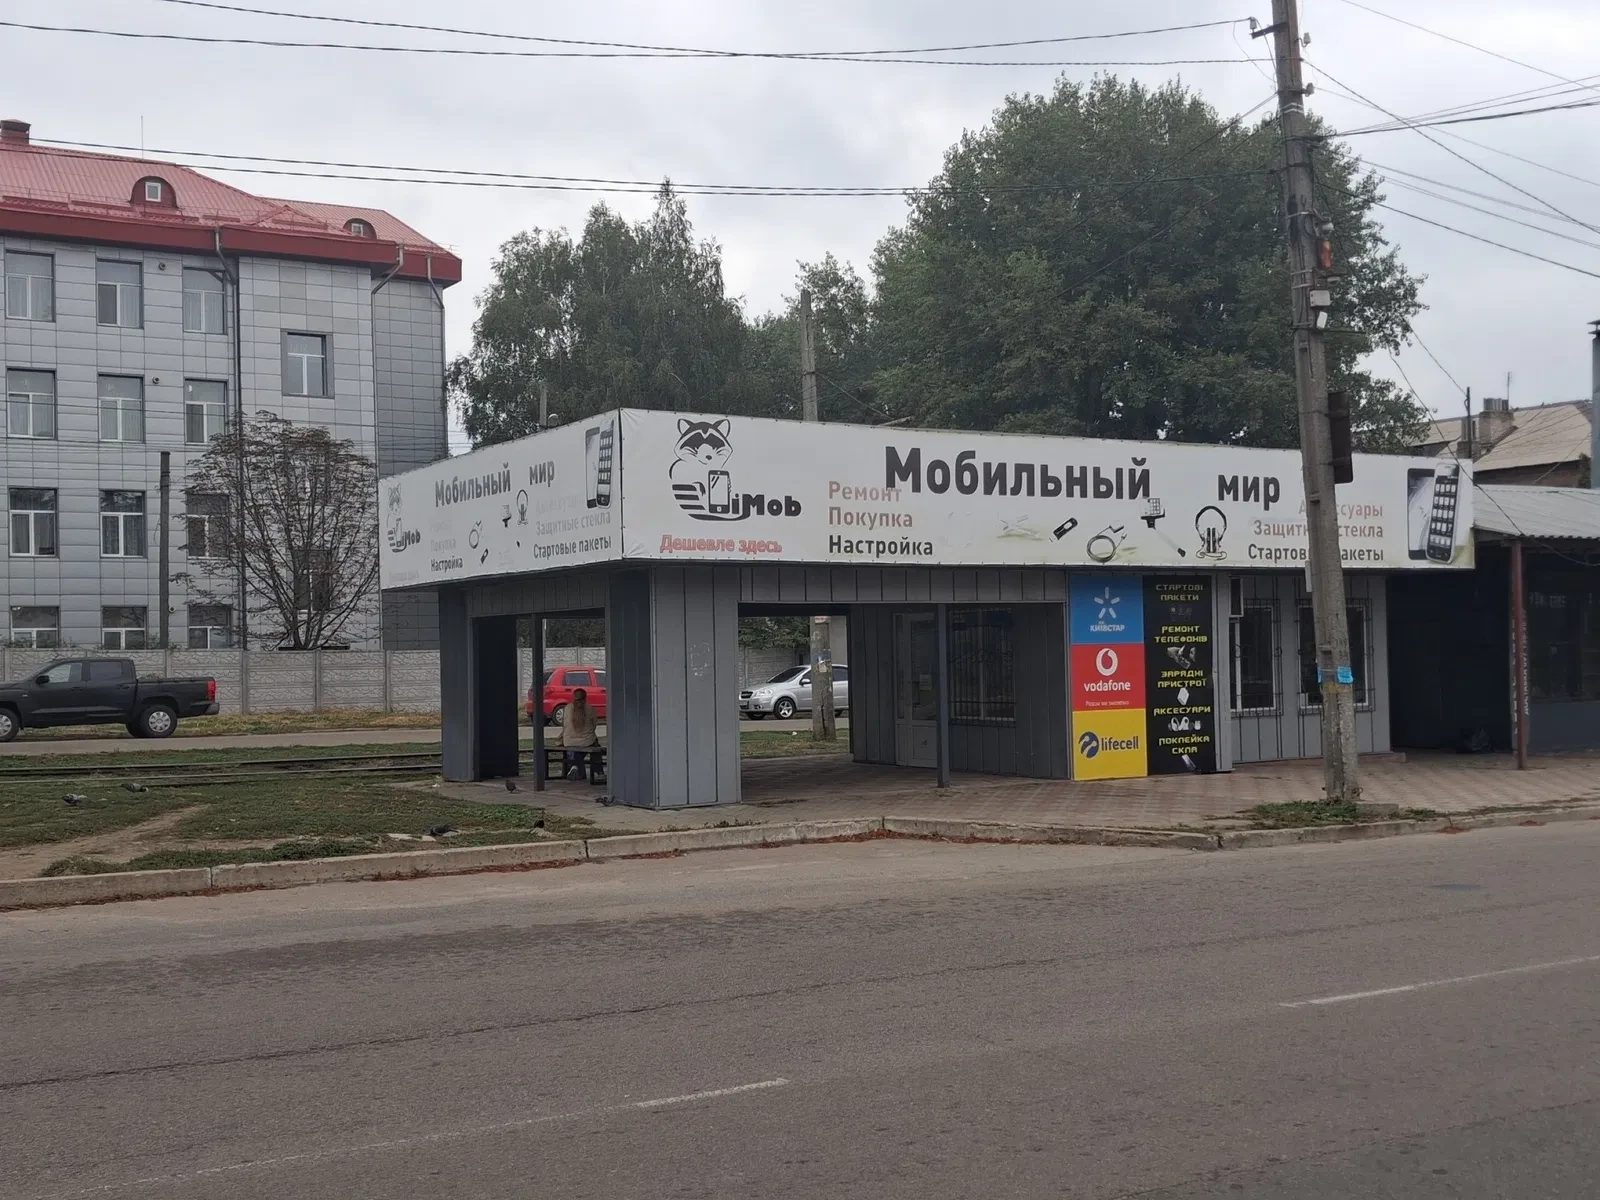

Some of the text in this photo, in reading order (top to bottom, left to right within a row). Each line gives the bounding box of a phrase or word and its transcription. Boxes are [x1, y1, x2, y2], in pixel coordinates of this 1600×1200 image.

[435, 462, 511, 508] Мобильный
[529, 460, 555, 487] мир
[885, 446, 1280, 511] Мобильный мир
[828, 481, 902, 502] Ремонт
[731, 493, 802, 517] iMob
[1298, 499, 1383, 519] Асуары
[536, 511, 611, 536] Защитные стекла
[828, 506, 913, 530] Покупка
[1253, 519, 1384, 540] Защитн стекла
[533, 536, 612, 561] Стартовые пакеты
[659, 534, 783, 554] Дешевле здесь
[828, 534, 933, 558] Настройка
[1248, 543, 1384, 564] Стартов акеты
[430, 555, 464, 574] Настройка
[1154, 635, 1207, 643] ТЕЛЕФОНІВ
[1161, 626, 1200, 634] РЕМОНТ
[1157, 678, 1207, 688] ПРИСТРОЇ
[1161, 670, 1203, 678] ЗАРЯДНІ
[1084, 680, 1131, 692] vodafone
[1154, 706, 1211, 717] АКСЕСУАРИ
[1101, 736, 1139, 751] lifecell
[1159, 734, 1210, 746] ПОКЛЕЙКА
[1171, 747, 1198, 755] СКЛА
